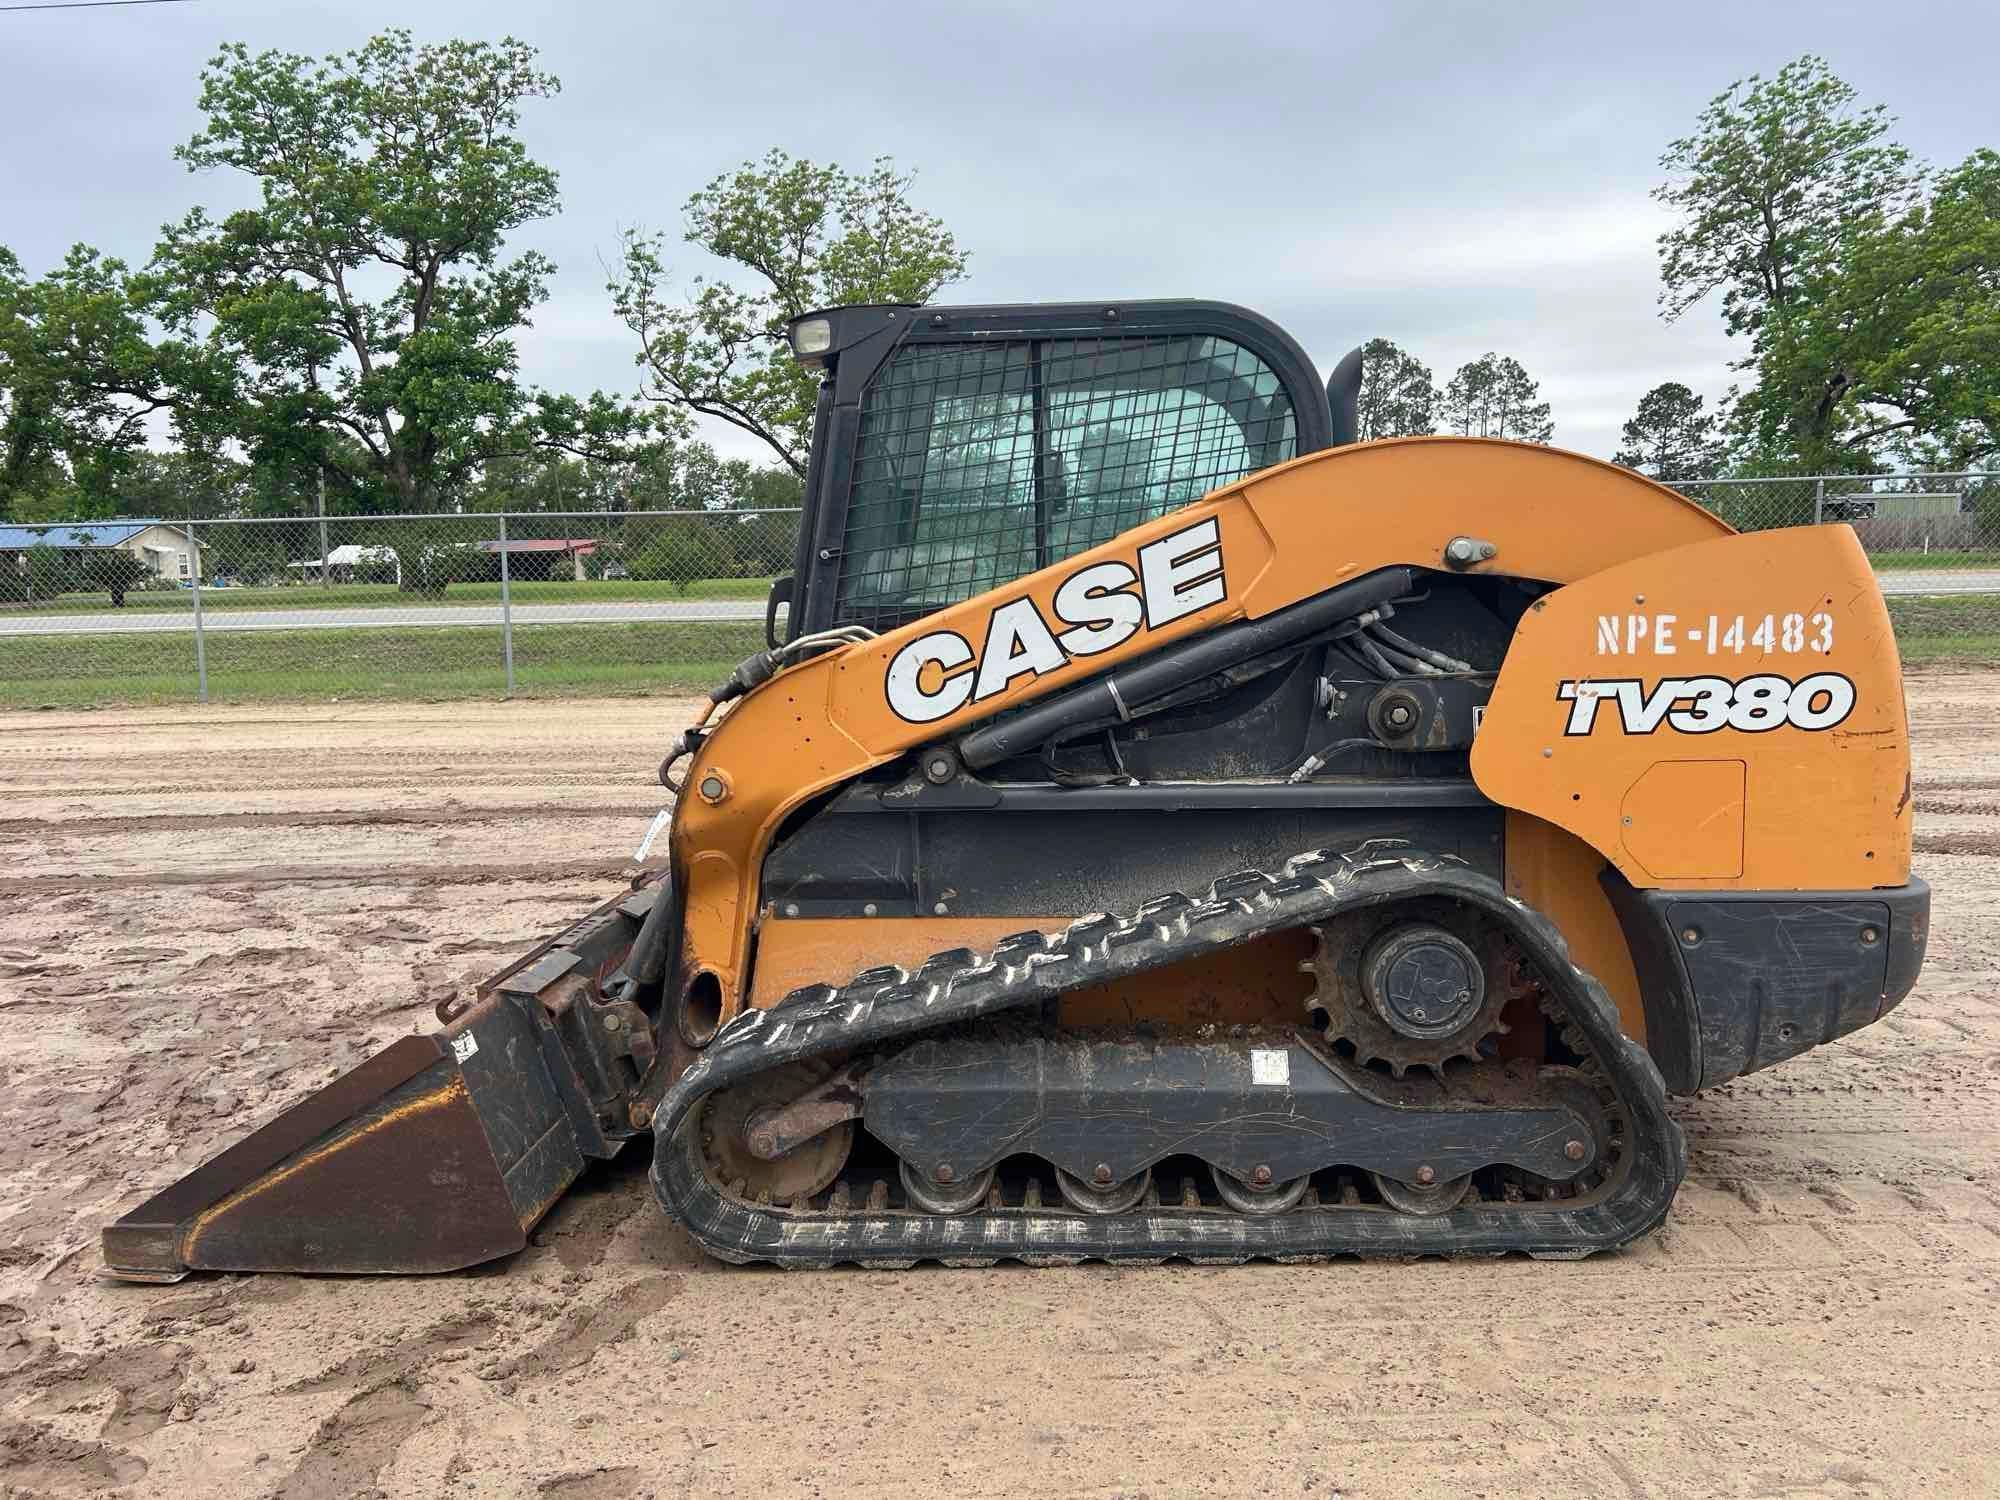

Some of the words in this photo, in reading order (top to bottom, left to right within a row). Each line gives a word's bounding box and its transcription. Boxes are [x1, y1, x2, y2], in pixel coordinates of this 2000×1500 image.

[885, 515, 1228, 724] CASE
[1597, 613, 1834, 655] NPE-14483
[1556, 671, 1857, 736] TV380
